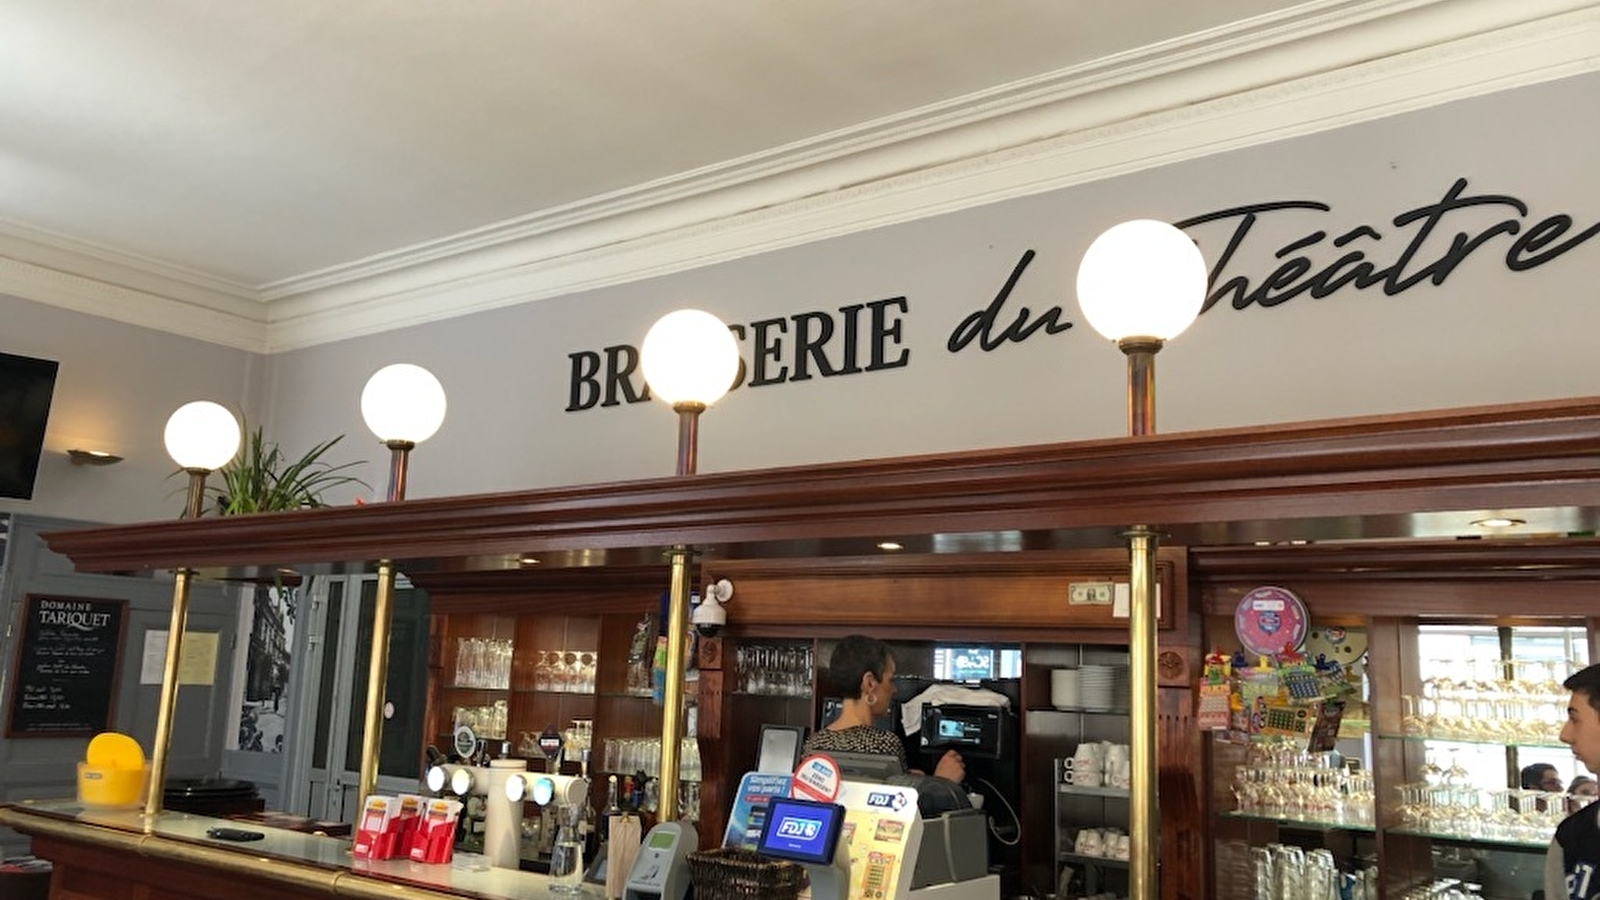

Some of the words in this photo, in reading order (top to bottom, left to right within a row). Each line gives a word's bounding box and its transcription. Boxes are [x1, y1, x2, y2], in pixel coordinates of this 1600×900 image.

[565, 296, 911, 412] BRERIE
[946, 249, 1073, 353] du
[1172, 177, 1600, 316] Théâtre
[40, 600, 92, 611] DOMAINE
[39, 610, 111, 631] TARIQUET
[868, 793, 889, 805] FDJ
[781, 821, 804, 835] FDJ
